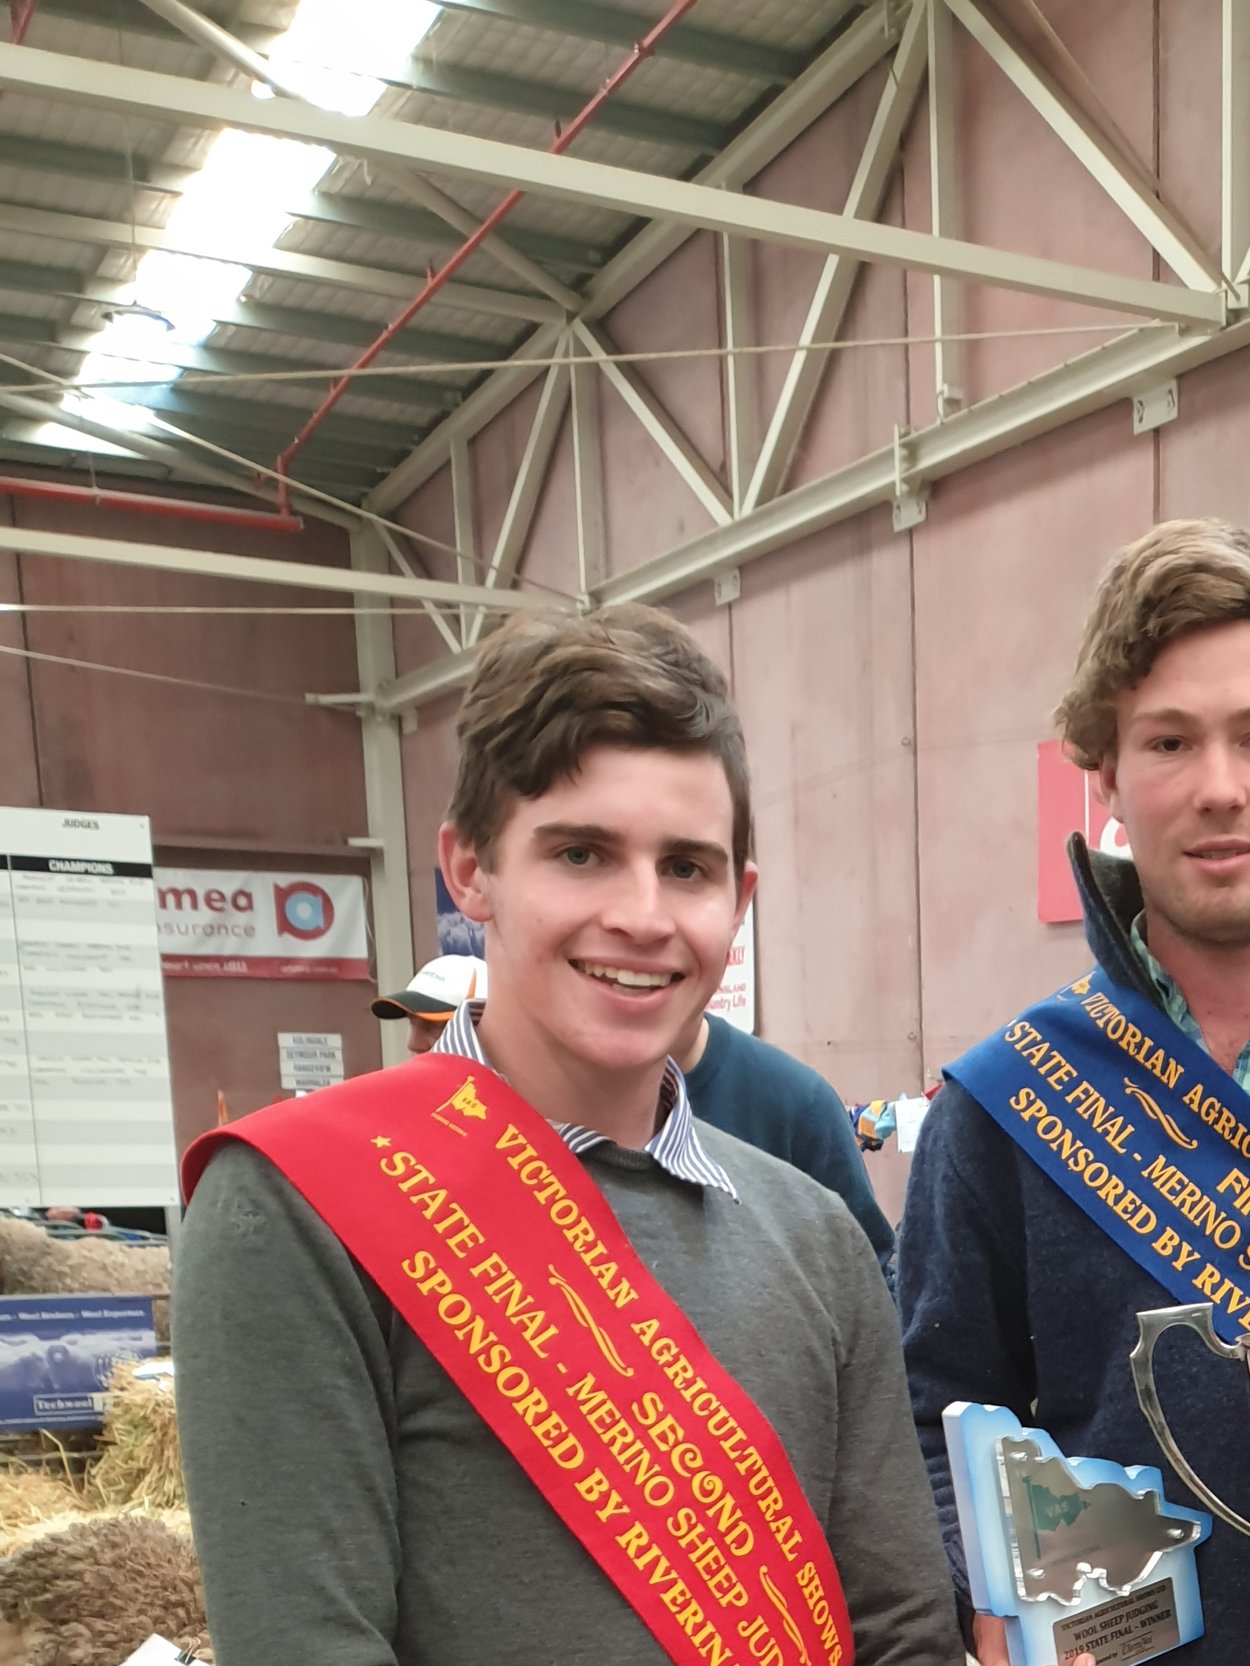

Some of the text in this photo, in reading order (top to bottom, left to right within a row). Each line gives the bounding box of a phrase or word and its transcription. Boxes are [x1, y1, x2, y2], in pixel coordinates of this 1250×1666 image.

[48, 858, 115, 875] CHAMPIONS
[157, 886, 255, 913] mea
[1080, 991, 1185, 1090] VICTORIAN
[1004, 1020, 1078, 1091] STATE
[1065, 1078, 1136, 1155] FINAL
[1141, 1154, 1243, 1250] MERINO
[1008, 1086, 1157, 1236] SPONSORED
[1152, 1226, 1203, 1274] BY
[379, 1150, 486, 1260] STATE
[470, 1251, 557, 1360] FINAL
[563, 1371, 675, 1509] MERINO
[666, 1505, 750, 1609] SHEEP
[401, 1249, 586, 1472] SPONSORED
[574, 1467, 630, 1525] BY
[494, 1123, 639, 1311] VICTORIAN
[632, 1317, 804, 1563] AGRICULTURAL
[631, 1390, 755, 1557] SECOND
[1073, 1600, 1159, 1642] WOOL SHEEP JUDGING
[1085, 1636, 1110, 1652] STATE
[1110, 1625, 1133, 1641] FINAL
[1140, 1608, 1172, 1629] WINNER
